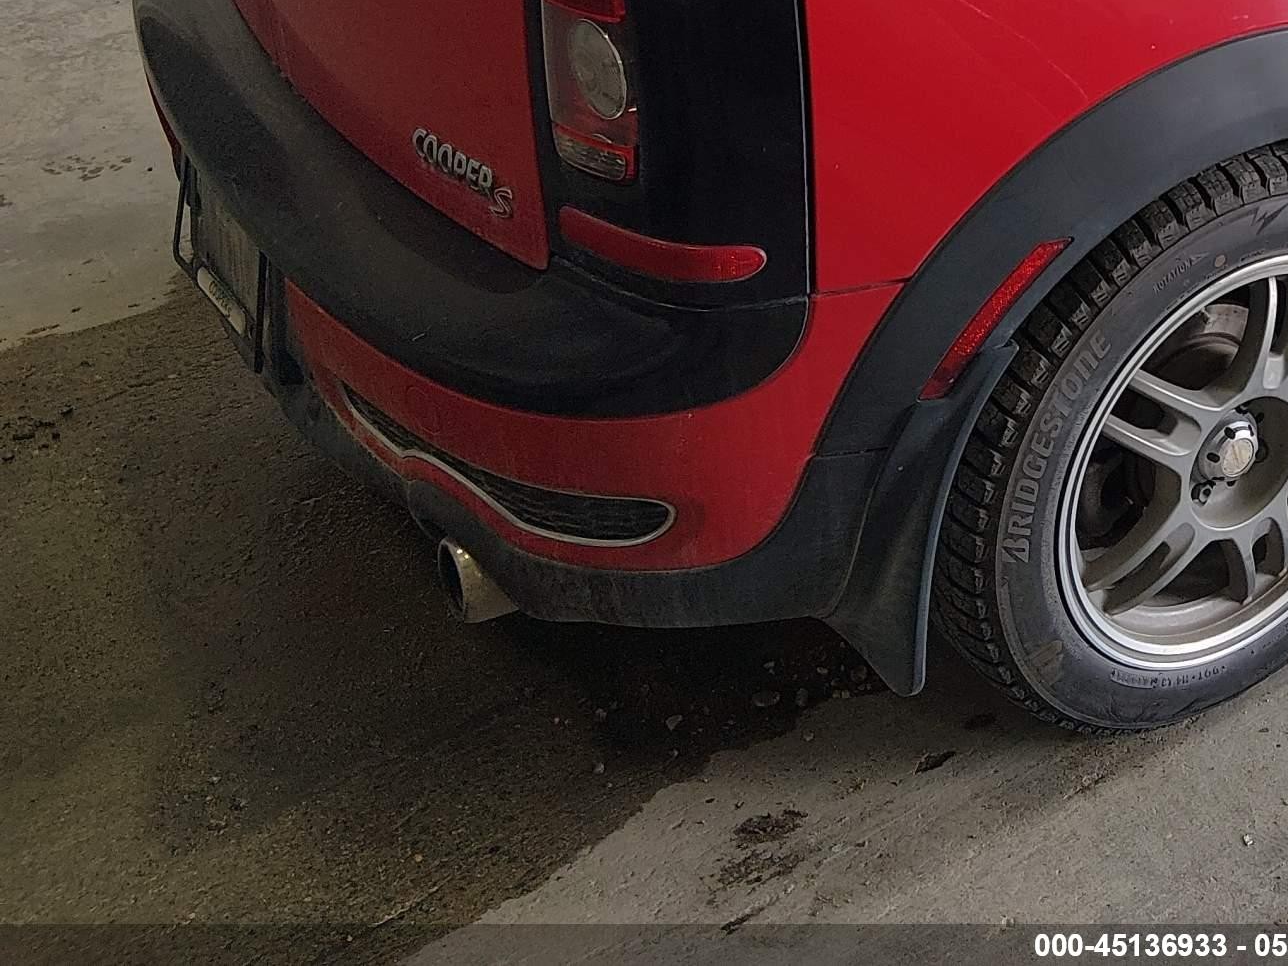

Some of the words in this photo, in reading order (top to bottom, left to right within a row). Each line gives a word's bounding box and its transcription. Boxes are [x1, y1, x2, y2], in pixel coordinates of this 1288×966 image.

[412, 127, 494, 194] COOPER
[488, 185, 514, 219] S
[1001, 334, 1112, 563] BRIDGESTONE
